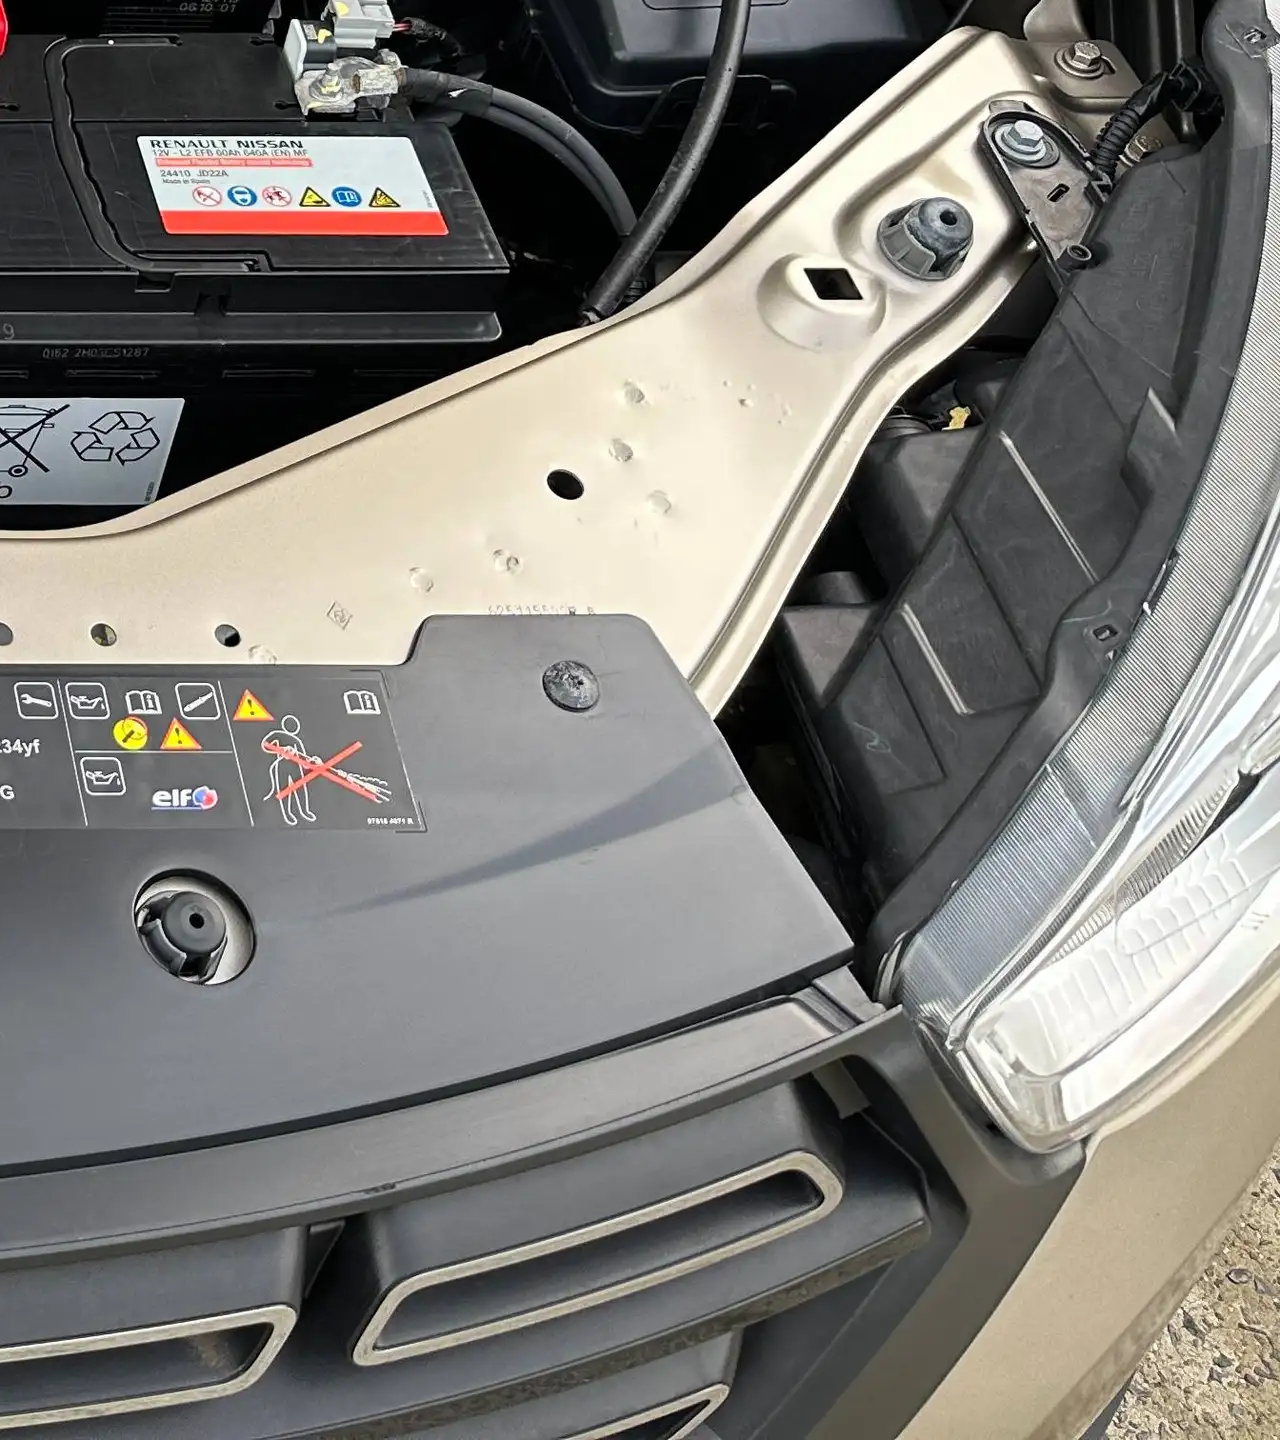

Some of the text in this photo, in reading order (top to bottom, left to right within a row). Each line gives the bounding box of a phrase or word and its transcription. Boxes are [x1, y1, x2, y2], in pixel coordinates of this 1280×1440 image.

[149, 139, 305, 150] RENAULT NISSAN
[151, 788, 191, 807] elf
